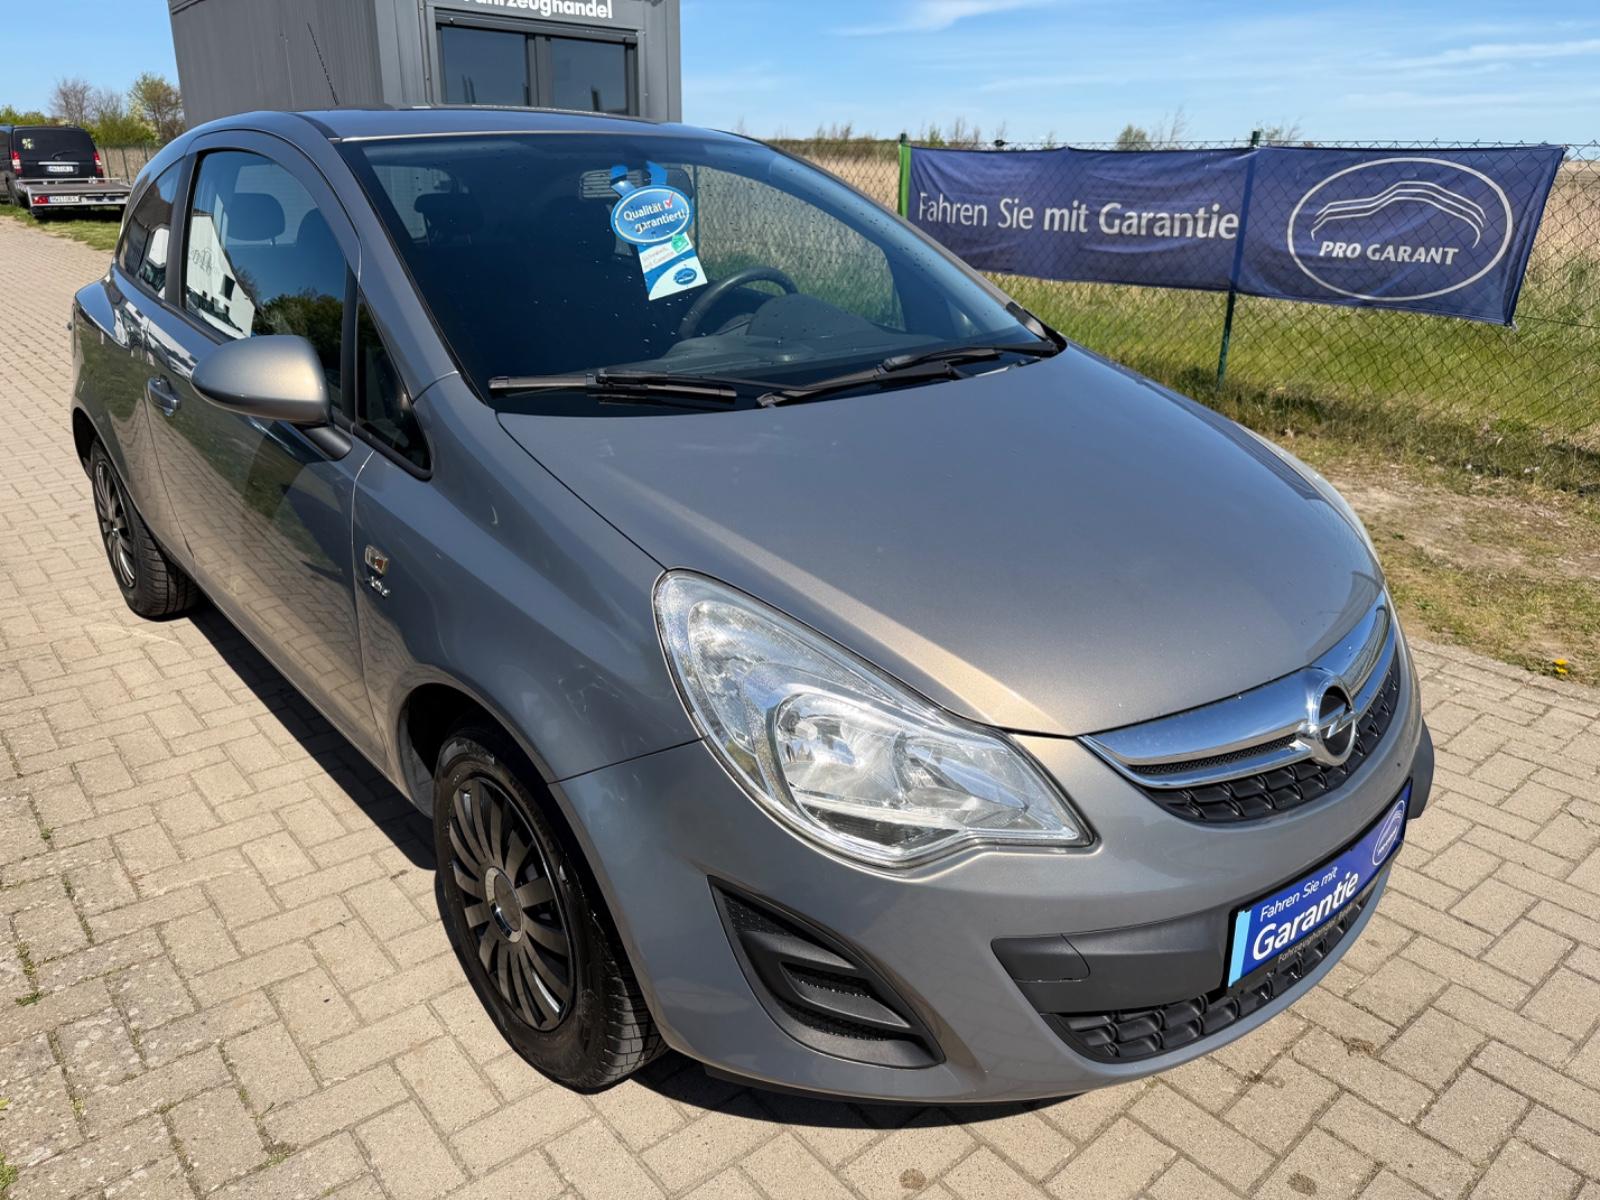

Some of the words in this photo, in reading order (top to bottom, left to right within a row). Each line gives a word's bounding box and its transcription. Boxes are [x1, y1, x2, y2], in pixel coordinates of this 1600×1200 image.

[463, 0, 613, 18] zeughandel
[623, 202, 662, 221] Qualität
[919, 192, 988, 227] Fahren
[998, 198, 1034, 230] Sie
[1043, 200, 1090, 232] mit
[1099, 202, 1239, 239] Garantie
[1319, 241, 1361, 259] PRO
[1366, 244, 1459, 265] GARANT
[1260, 892, 1300, 922] Fahren
[1302, 880, 1320, 898] Sie
[1320, 866, 1338, 887] mit
[1253, 871, 1358, 960] Garantie
